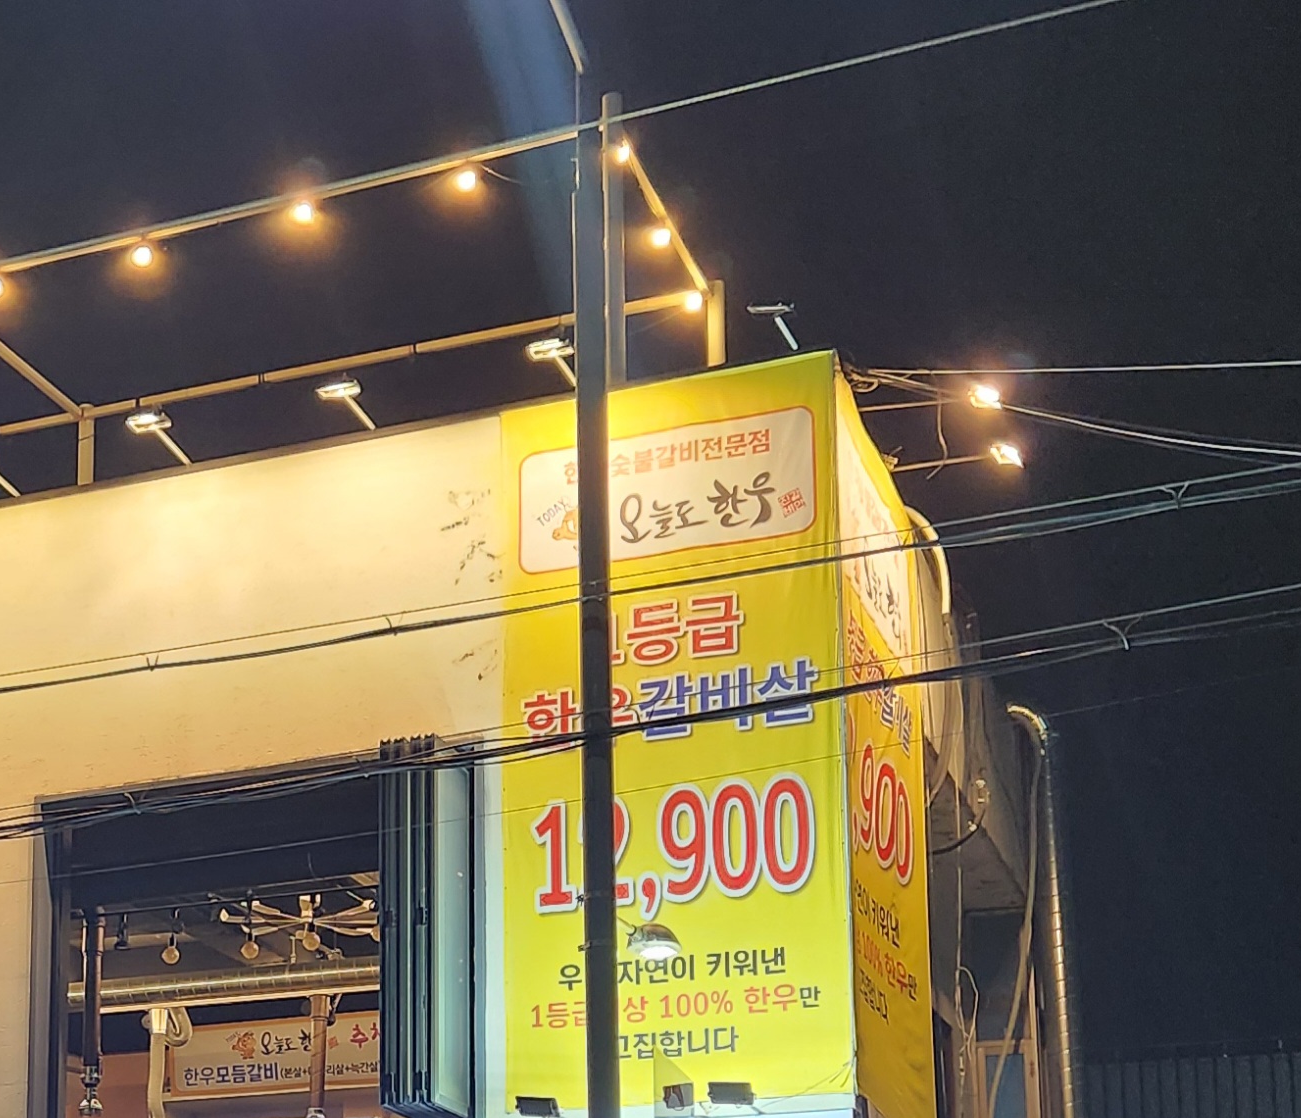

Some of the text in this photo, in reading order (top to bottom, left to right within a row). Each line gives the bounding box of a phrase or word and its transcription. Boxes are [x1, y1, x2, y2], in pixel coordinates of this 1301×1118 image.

[564, 429, 771, 486] 한숯불갈비전문점
[619, 471, 776, 544] 오늘도 한우
[706, 946, 787, 979] 키워낸
[623, 995, 649, 1024] 상
[659, 989, 734, 1019] 100%
[744, 984, 822, 1014] 한우만
[260, 1031, 299, 1055] 오늘도
[298, 1029, 312, 1052] 한
[184, 1062, 279, 1087] 한우모듬갈비
